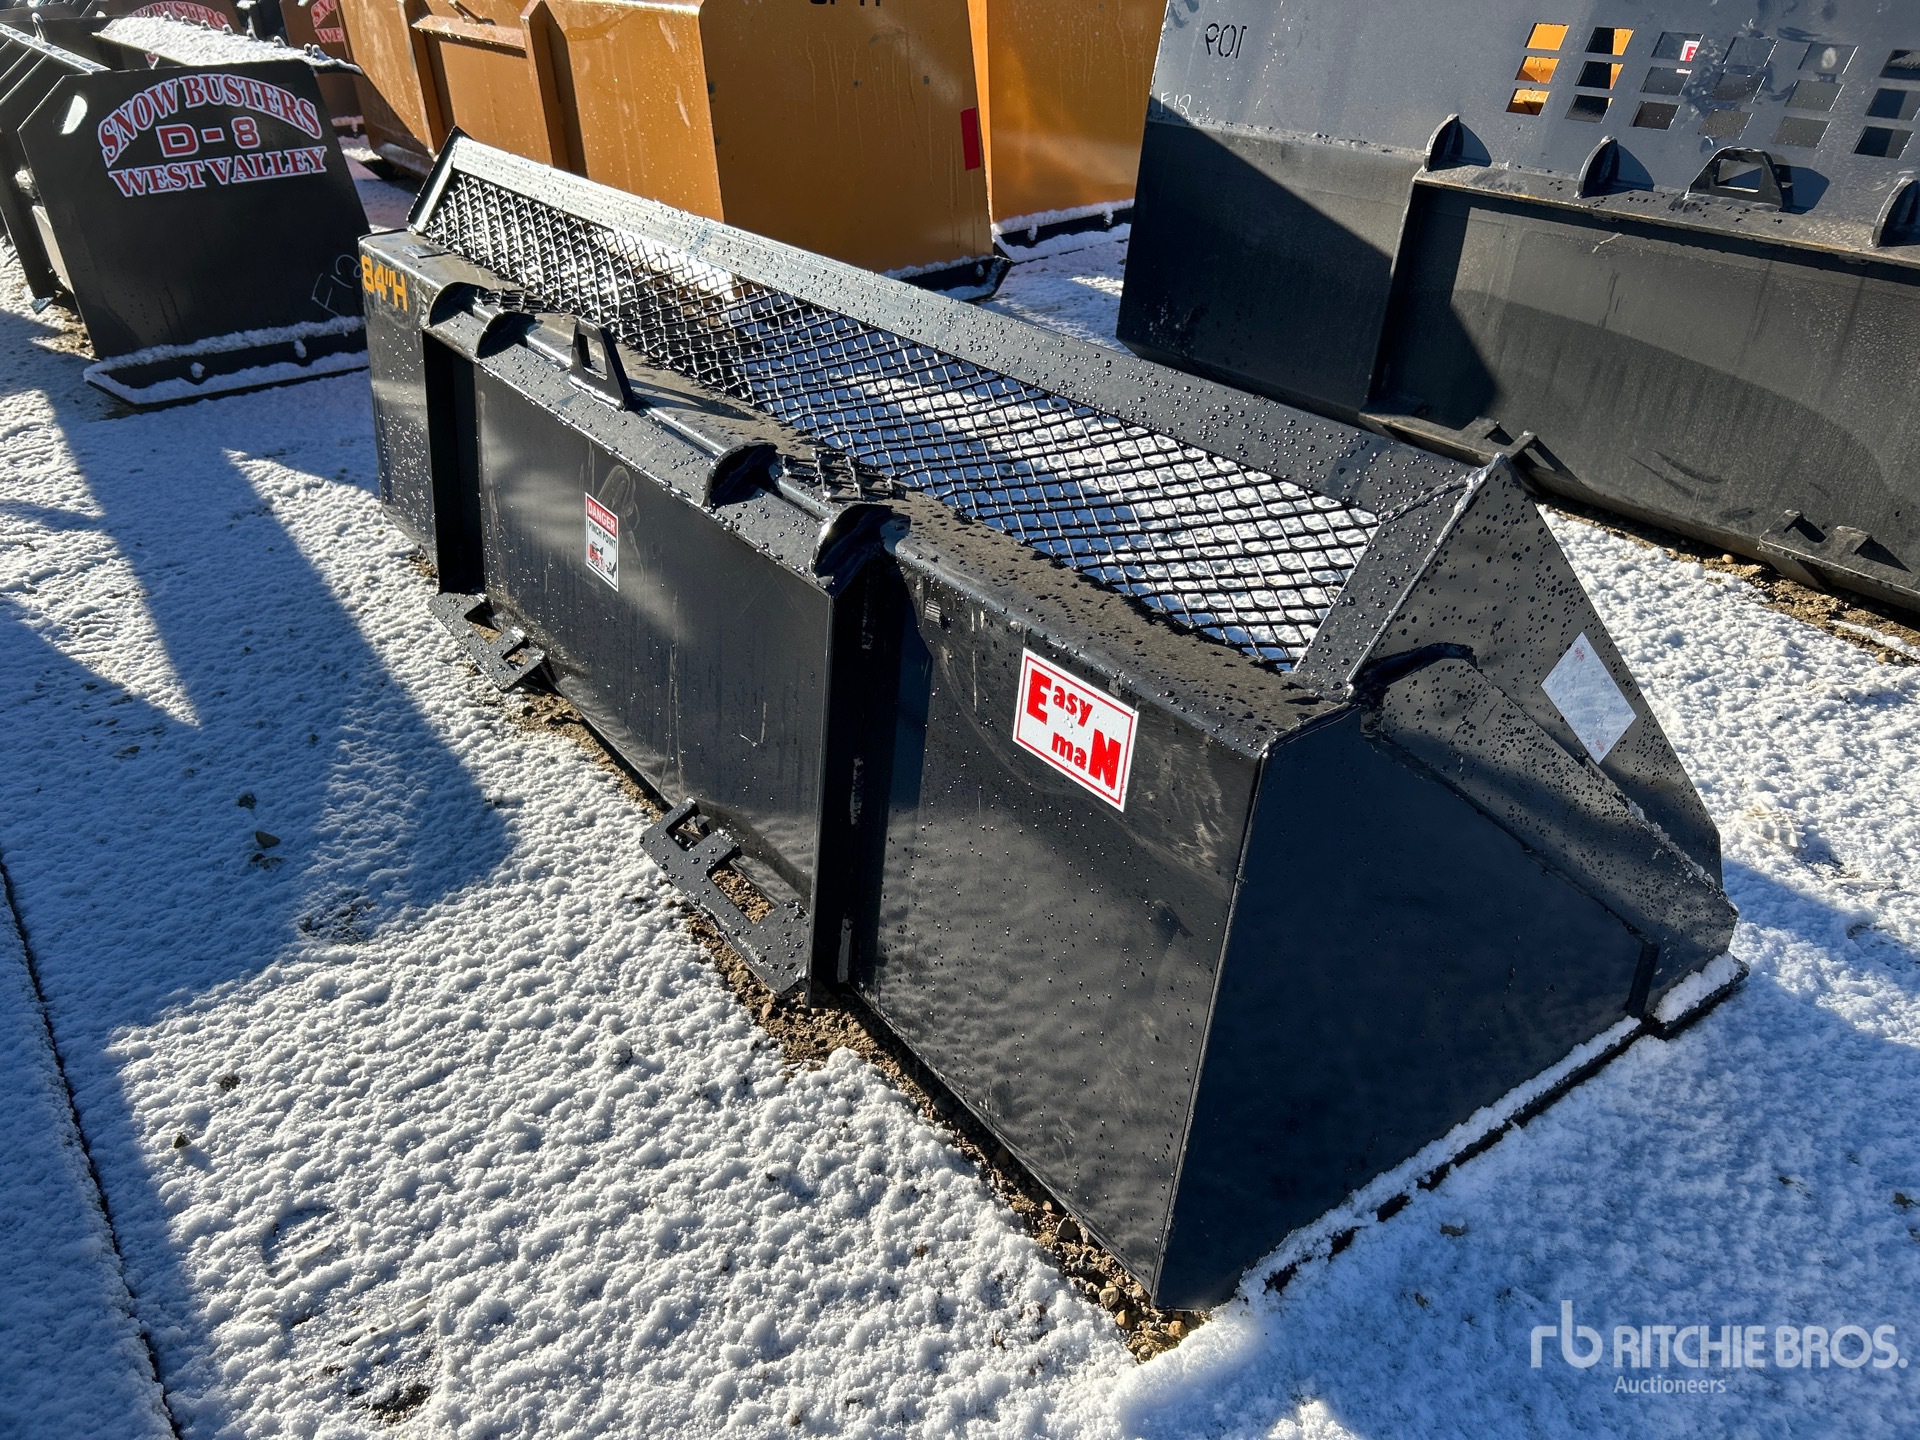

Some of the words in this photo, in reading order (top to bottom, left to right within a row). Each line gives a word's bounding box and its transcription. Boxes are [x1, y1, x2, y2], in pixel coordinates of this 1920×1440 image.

[98, 77, 179, 168] SNOW
[179, 73, 322, 139] BUSTERS
[108, 160, 206, 198] WEST
[206, 146, 327, 185] VALLEY
[588, 500, 616, 535] DANGER
[602, 530, 616, 550] POINT
